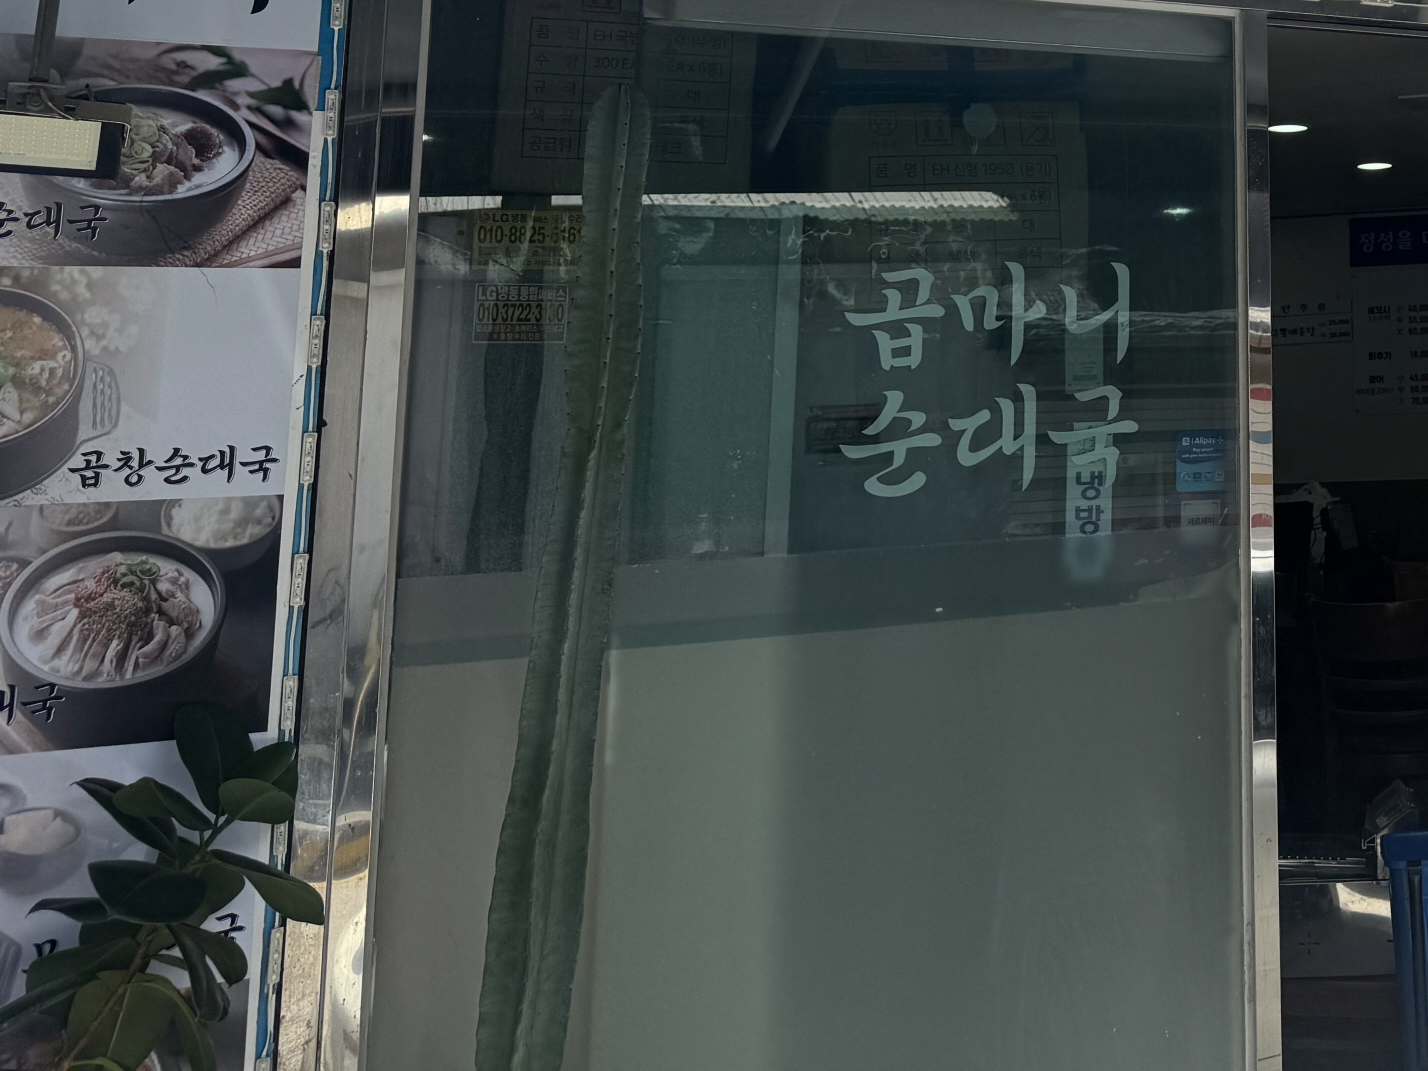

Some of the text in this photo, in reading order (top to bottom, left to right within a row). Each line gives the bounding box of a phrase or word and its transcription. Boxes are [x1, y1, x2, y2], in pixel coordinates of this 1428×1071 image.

[1358, 230, 1414, 254] 정성을
[843, 260, 1131, 373] 곱마니
[67, 442, 281, 489] 곱창순대국
[839, 382, 1140, 499] 순대국
